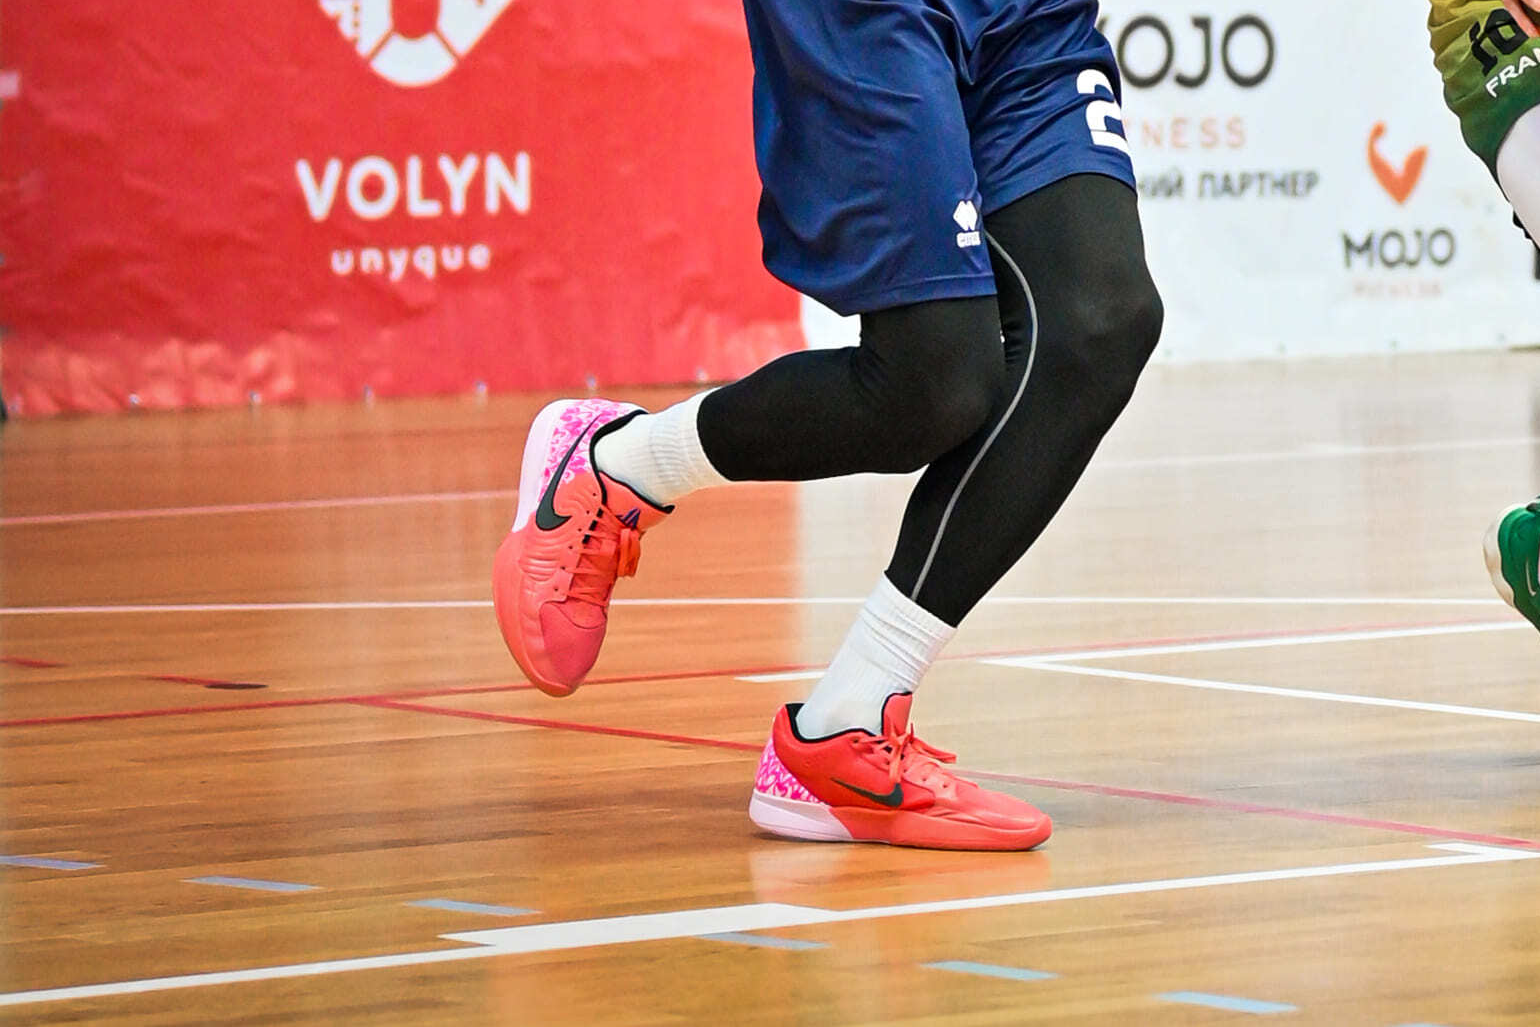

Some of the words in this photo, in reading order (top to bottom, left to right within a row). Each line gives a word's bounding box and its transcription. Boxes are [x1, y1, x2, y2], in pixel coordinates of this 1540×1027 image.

[1098, 13, 1276, 90] OJO
[296, 152, 532, 222] VOLYN
[1198, 171, 1320, 199] ПАРТНЕР
[331, 244, 491, 282] unyque
[1342, 227, 1456, 269] MOJO
